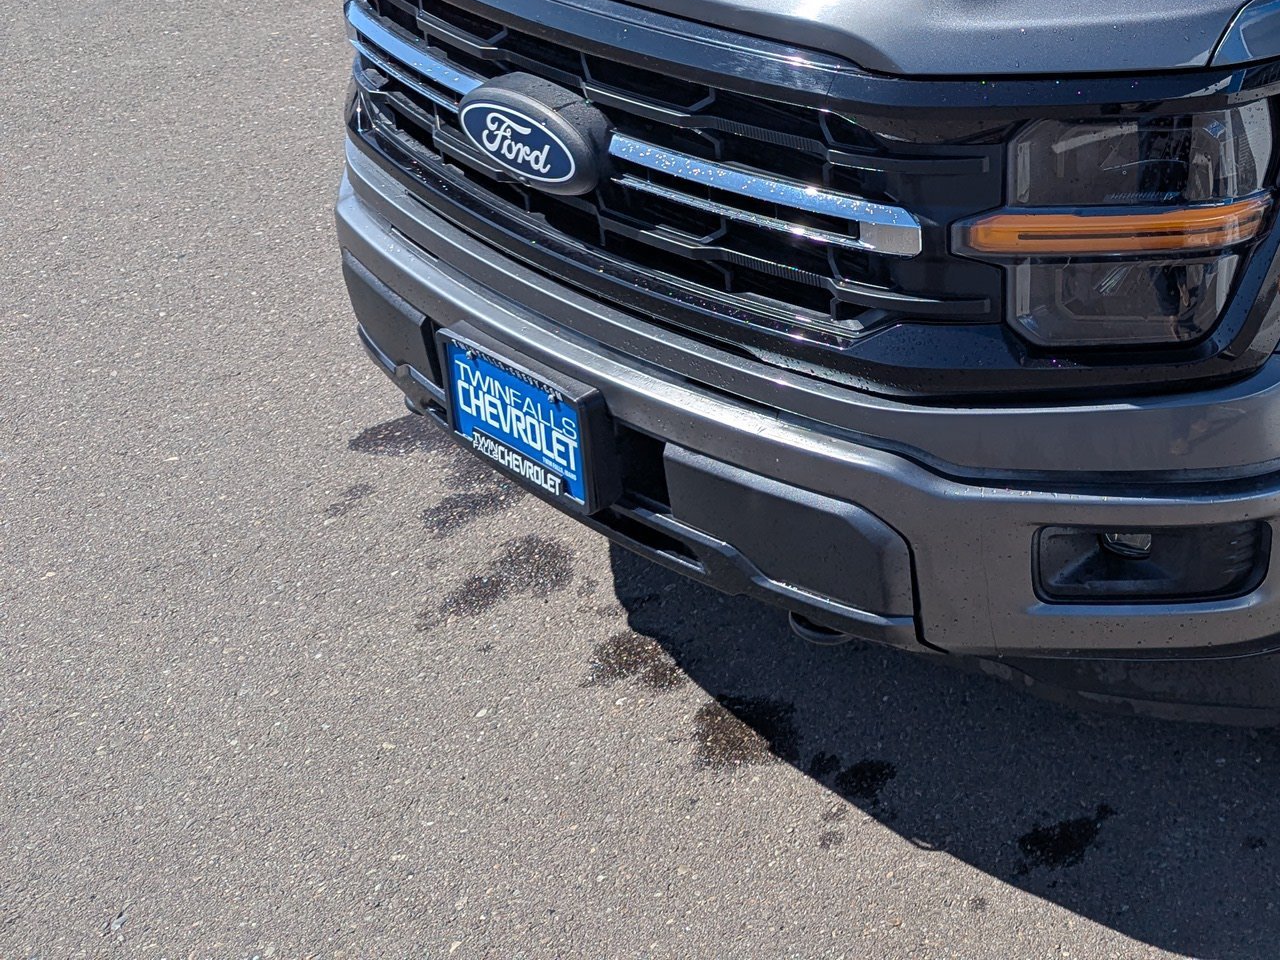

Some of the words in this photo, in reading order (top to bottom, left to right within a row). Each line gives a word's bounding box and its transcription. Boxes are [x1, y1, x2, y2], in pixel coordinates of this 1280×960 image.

[482, 112, 552, 174] Ford
[457, 379, 578, 472] CHEVROLET
[472, 431, 498, 451] TWIN
[498, 445, 561, 496] CHEVROLET
